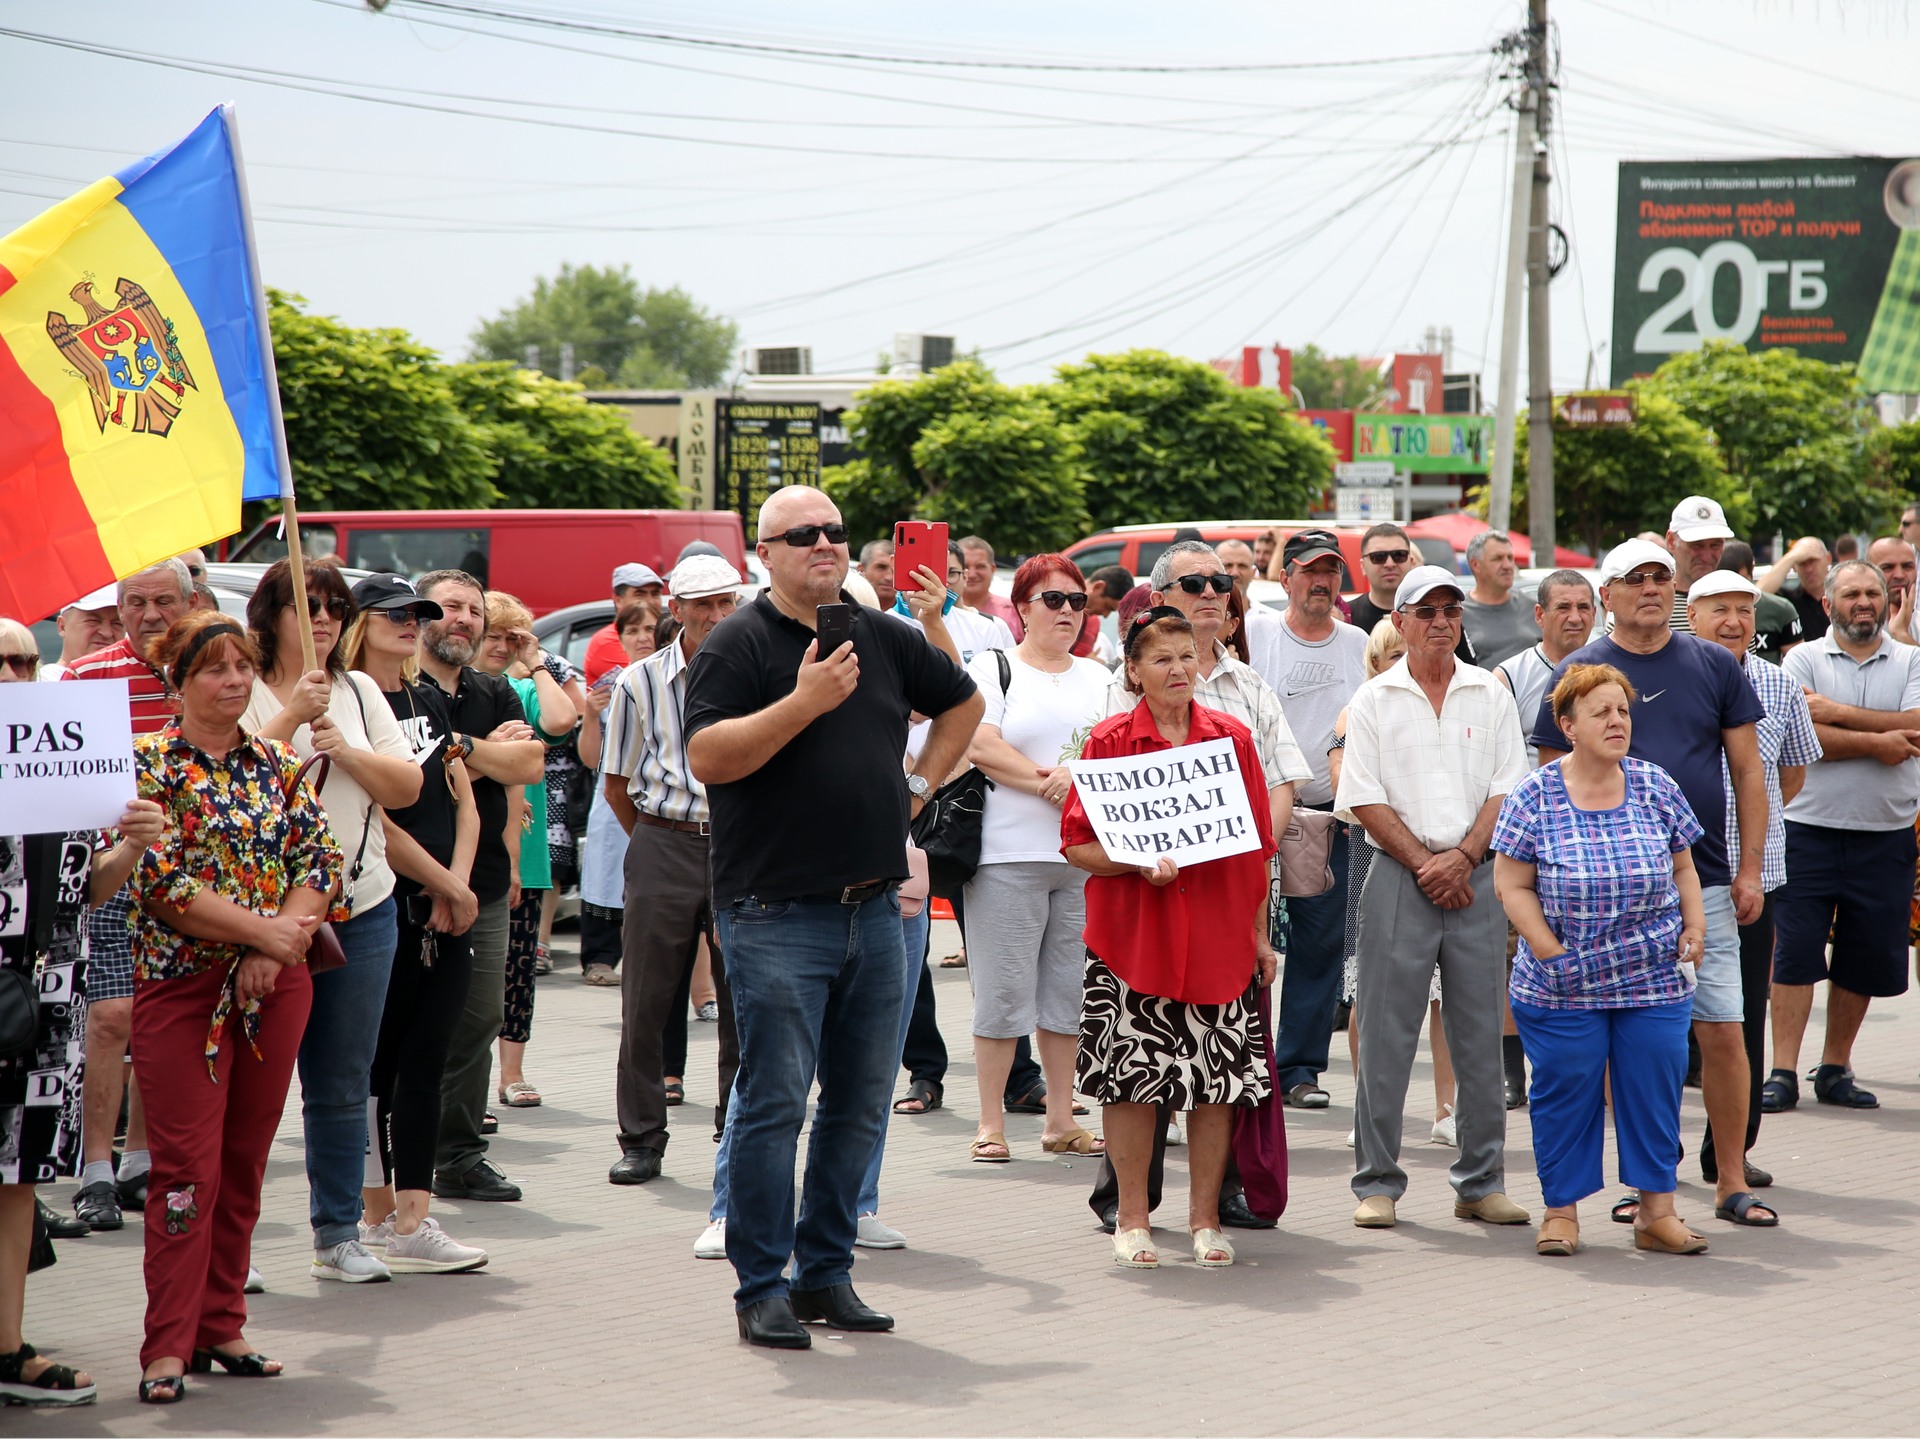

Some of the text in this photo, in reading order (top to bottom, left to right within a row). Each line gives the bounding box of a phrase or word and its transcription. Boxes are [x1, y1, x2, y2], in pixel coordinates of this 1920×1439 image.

[1640, 174, 1857, 191] Интернета слишком много не бывает
[1640, 199, 1795, 220] Подключи любой
[1639, 221, 1734, 238] абонемент
[1781, 222, 1792, 236] и
[1796, 221, 1861, 239] получи
[1762, 316, 1834, 329] бесплатно
[1358, 423, 1467, 458] КАТЮША
[1288, 661, 1336, 684] NIKE
[6, 720, 84, 754] PAS
[14, 757, 129, 779] МОЛДОВЫ!
[1076, 752, 1236, 792] ЧЕМОДАН
[1101, 786, 1227, 823] ВОКЗАЛ
[1103, 815, 1247, 853] ГАРВАРД!
